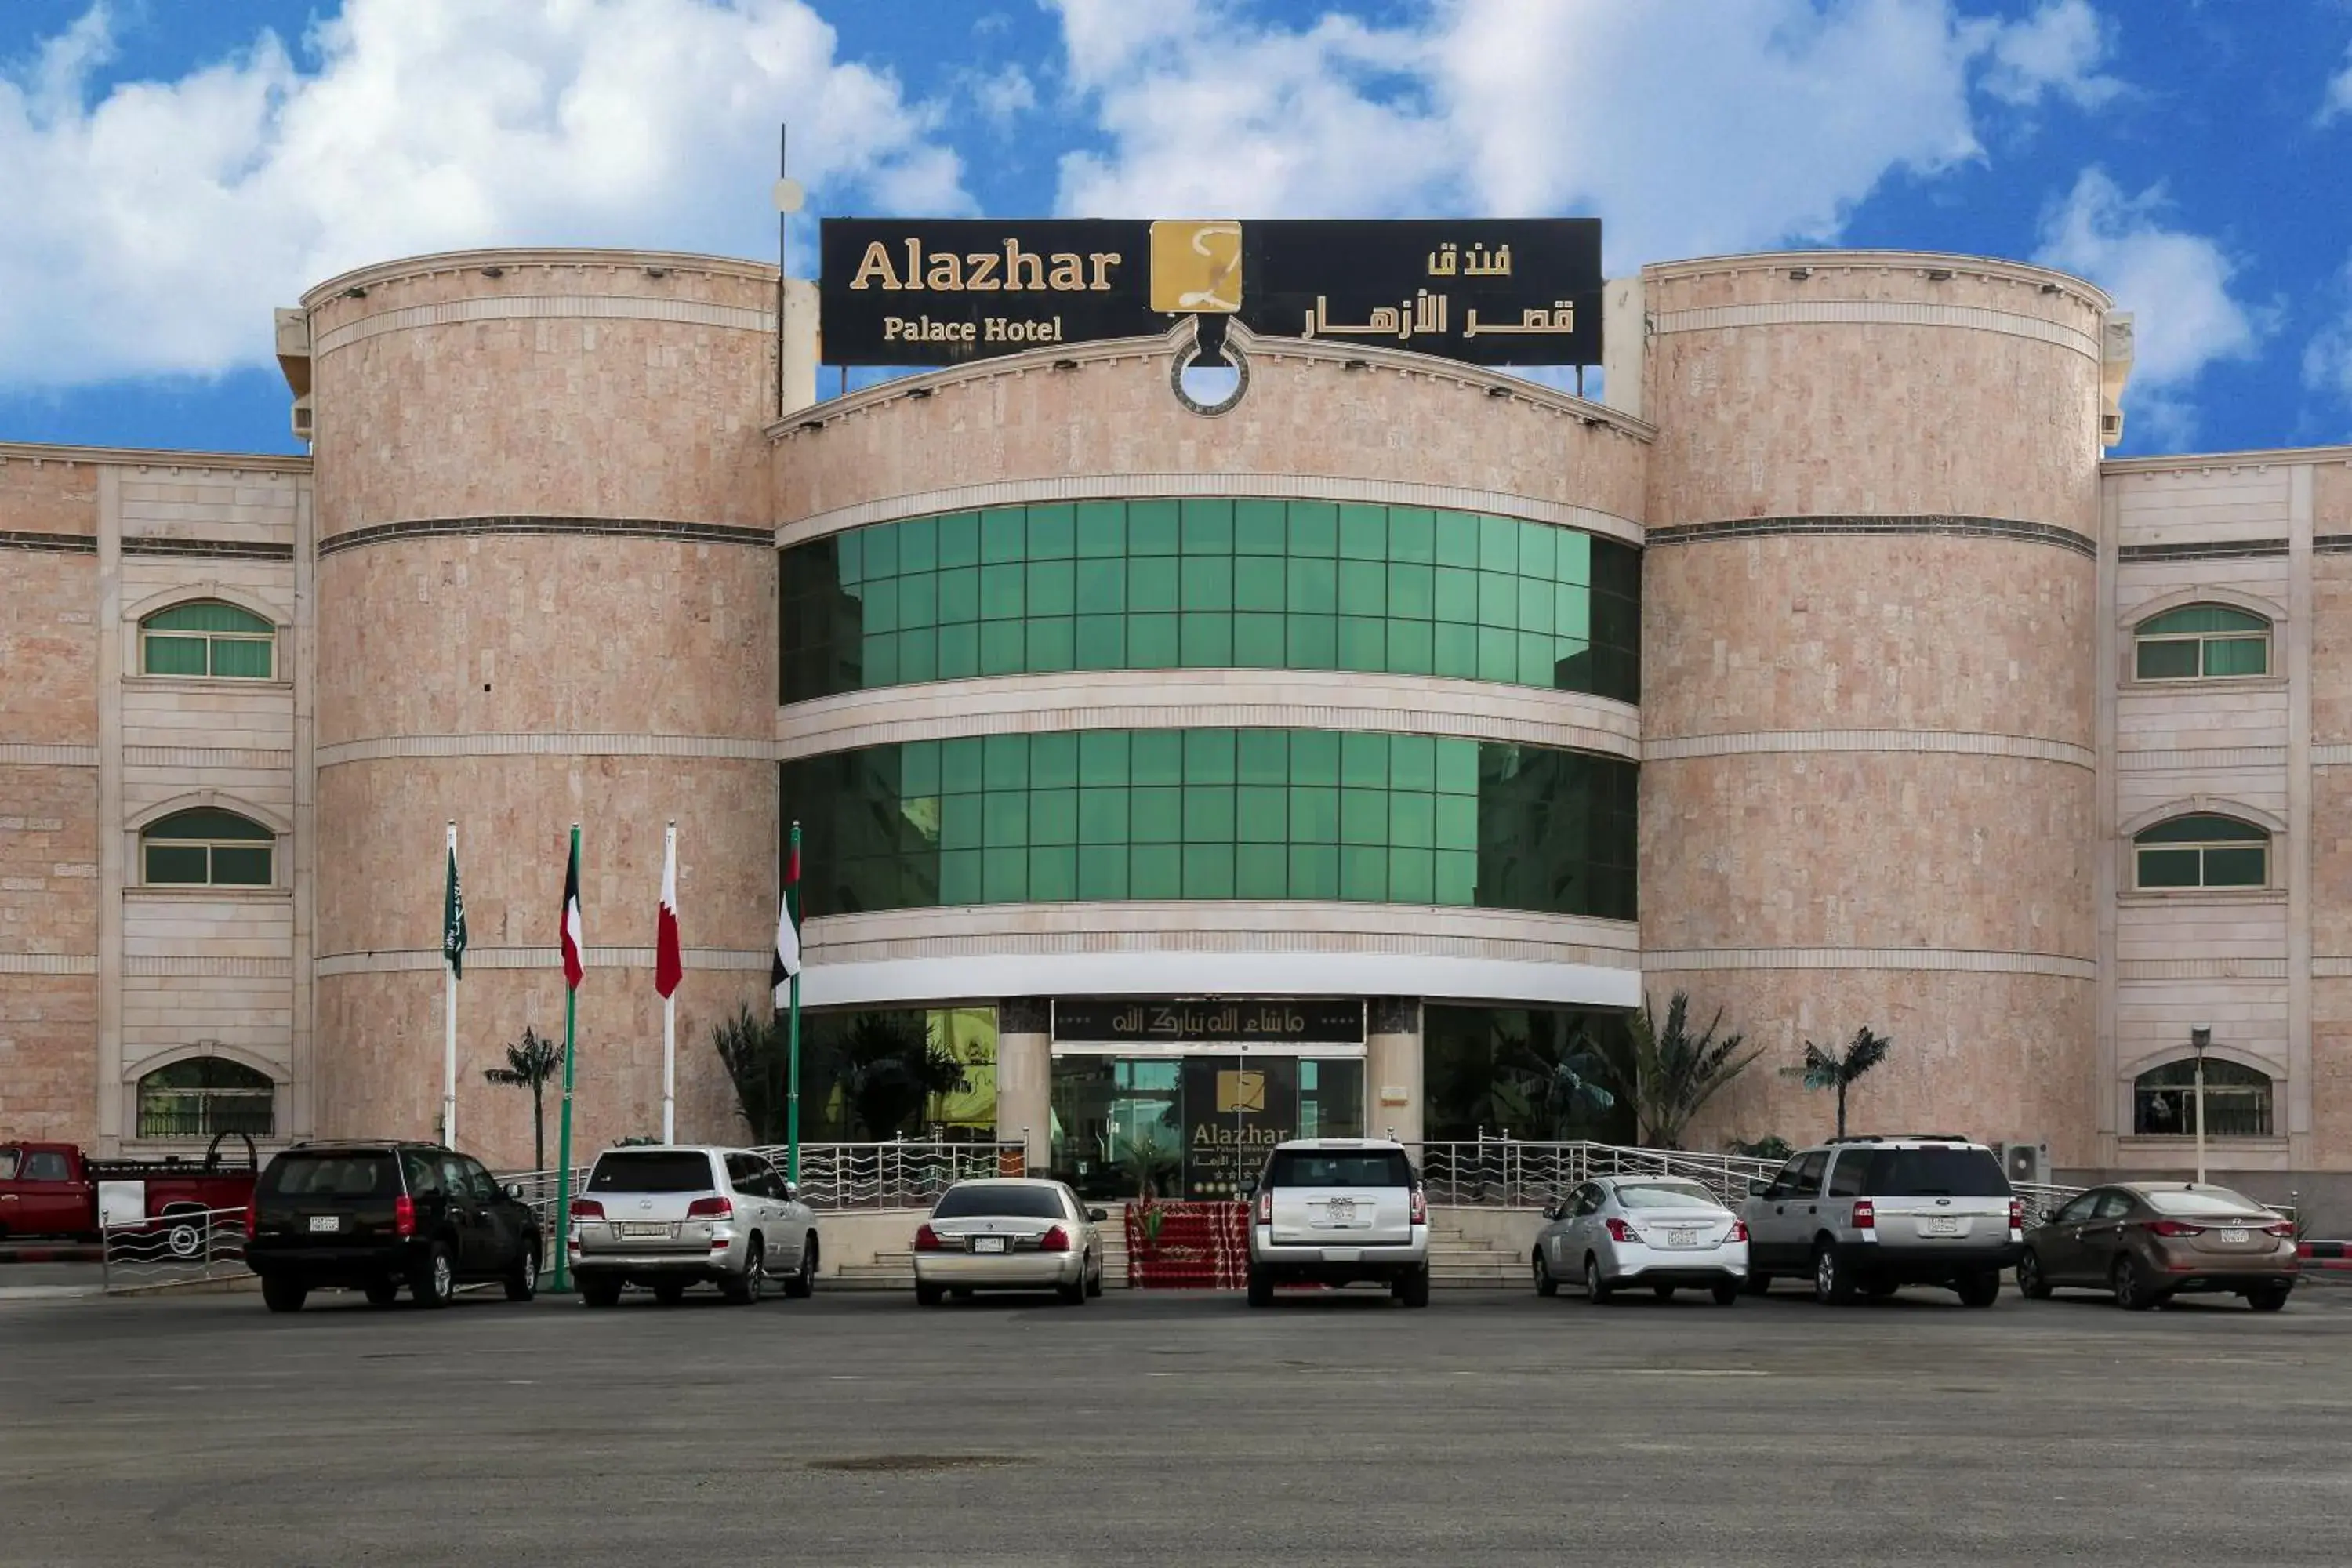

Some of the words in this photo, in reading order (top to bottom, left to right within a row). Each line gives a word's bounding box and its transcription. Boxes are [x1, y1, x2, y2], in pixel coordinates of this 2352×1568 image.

[849, 238, 1122, 291] Alazhar
[1428, 242, 1511, 275] فندق
[1301, 288, 1447, 339] الأزهار
[1463, 300, 1573, 339] قصر
[884, 315, 976, 341] Palace
[984, 316, 1063, 341] Hotel
[1112, 1005, 1144, 1033] الله
[1148, 1007, 1203, 1038] تبارك
[1207, 1006, 1239, 1033] الله
[1243, 1007, 1282, 1033] شاء
[1284, 1008, 1305, 1033] ما
[1192, 1123, 1290, 1145] Alazhar
